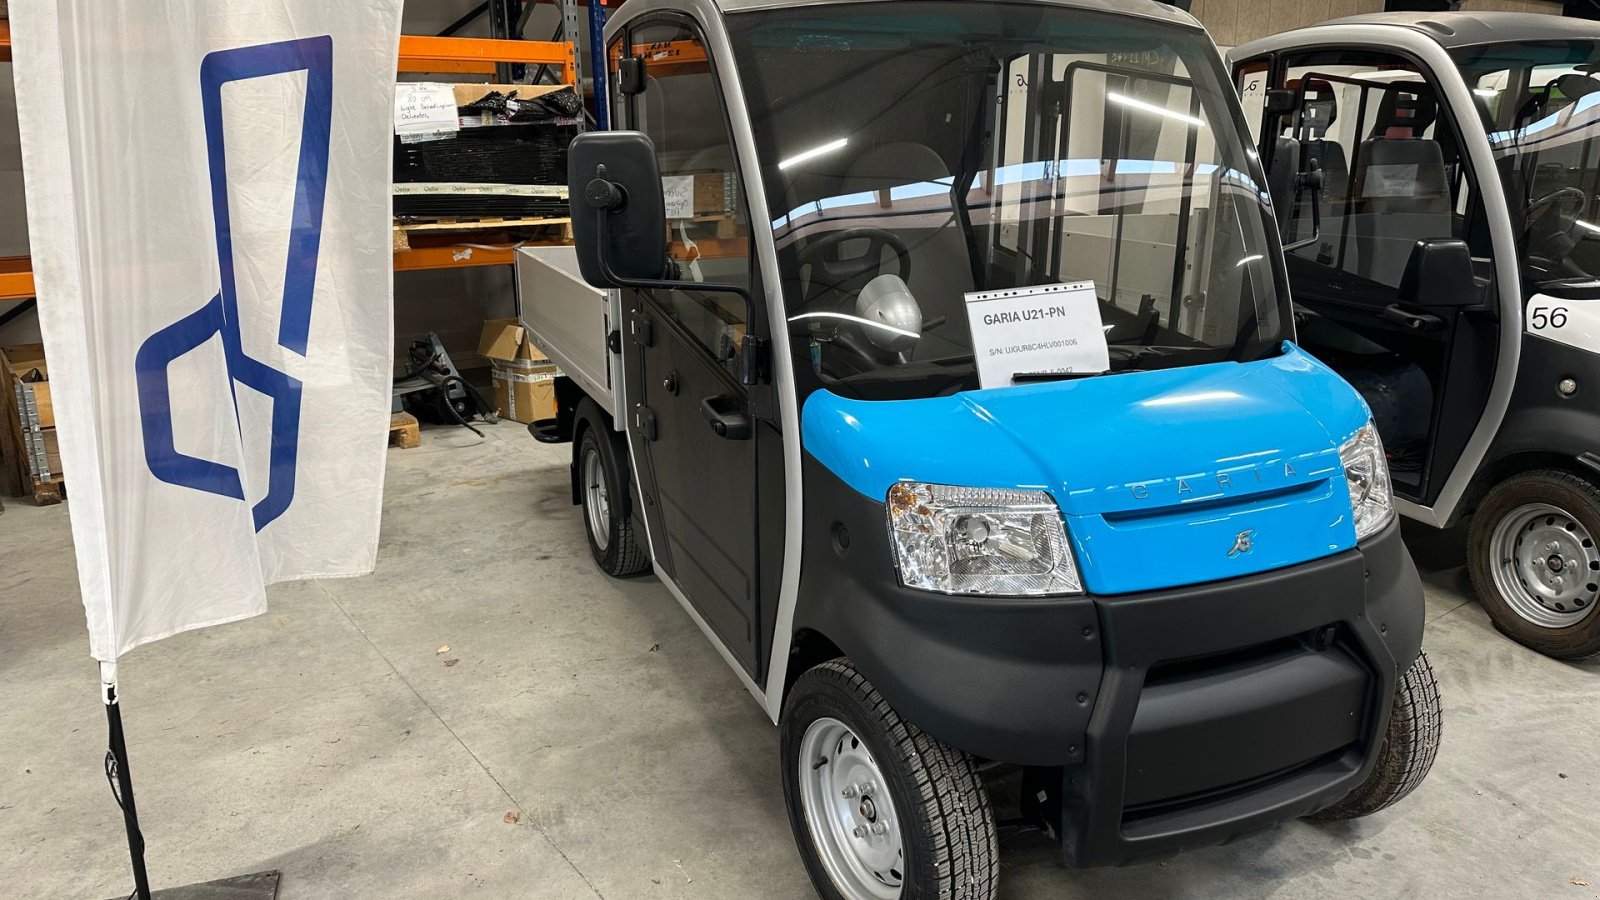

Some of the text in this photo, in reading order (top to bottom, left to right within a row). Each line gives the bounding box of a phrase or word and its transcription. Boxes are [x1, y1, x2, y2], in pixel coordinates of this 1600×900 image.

[983, 306, 1066, 325] GARIA U21-PN
[1532, 306, 1568, 330] 56
[989, 348, 1004, 356] S/N:
[1132, 462, 1297, 500] GARIA
